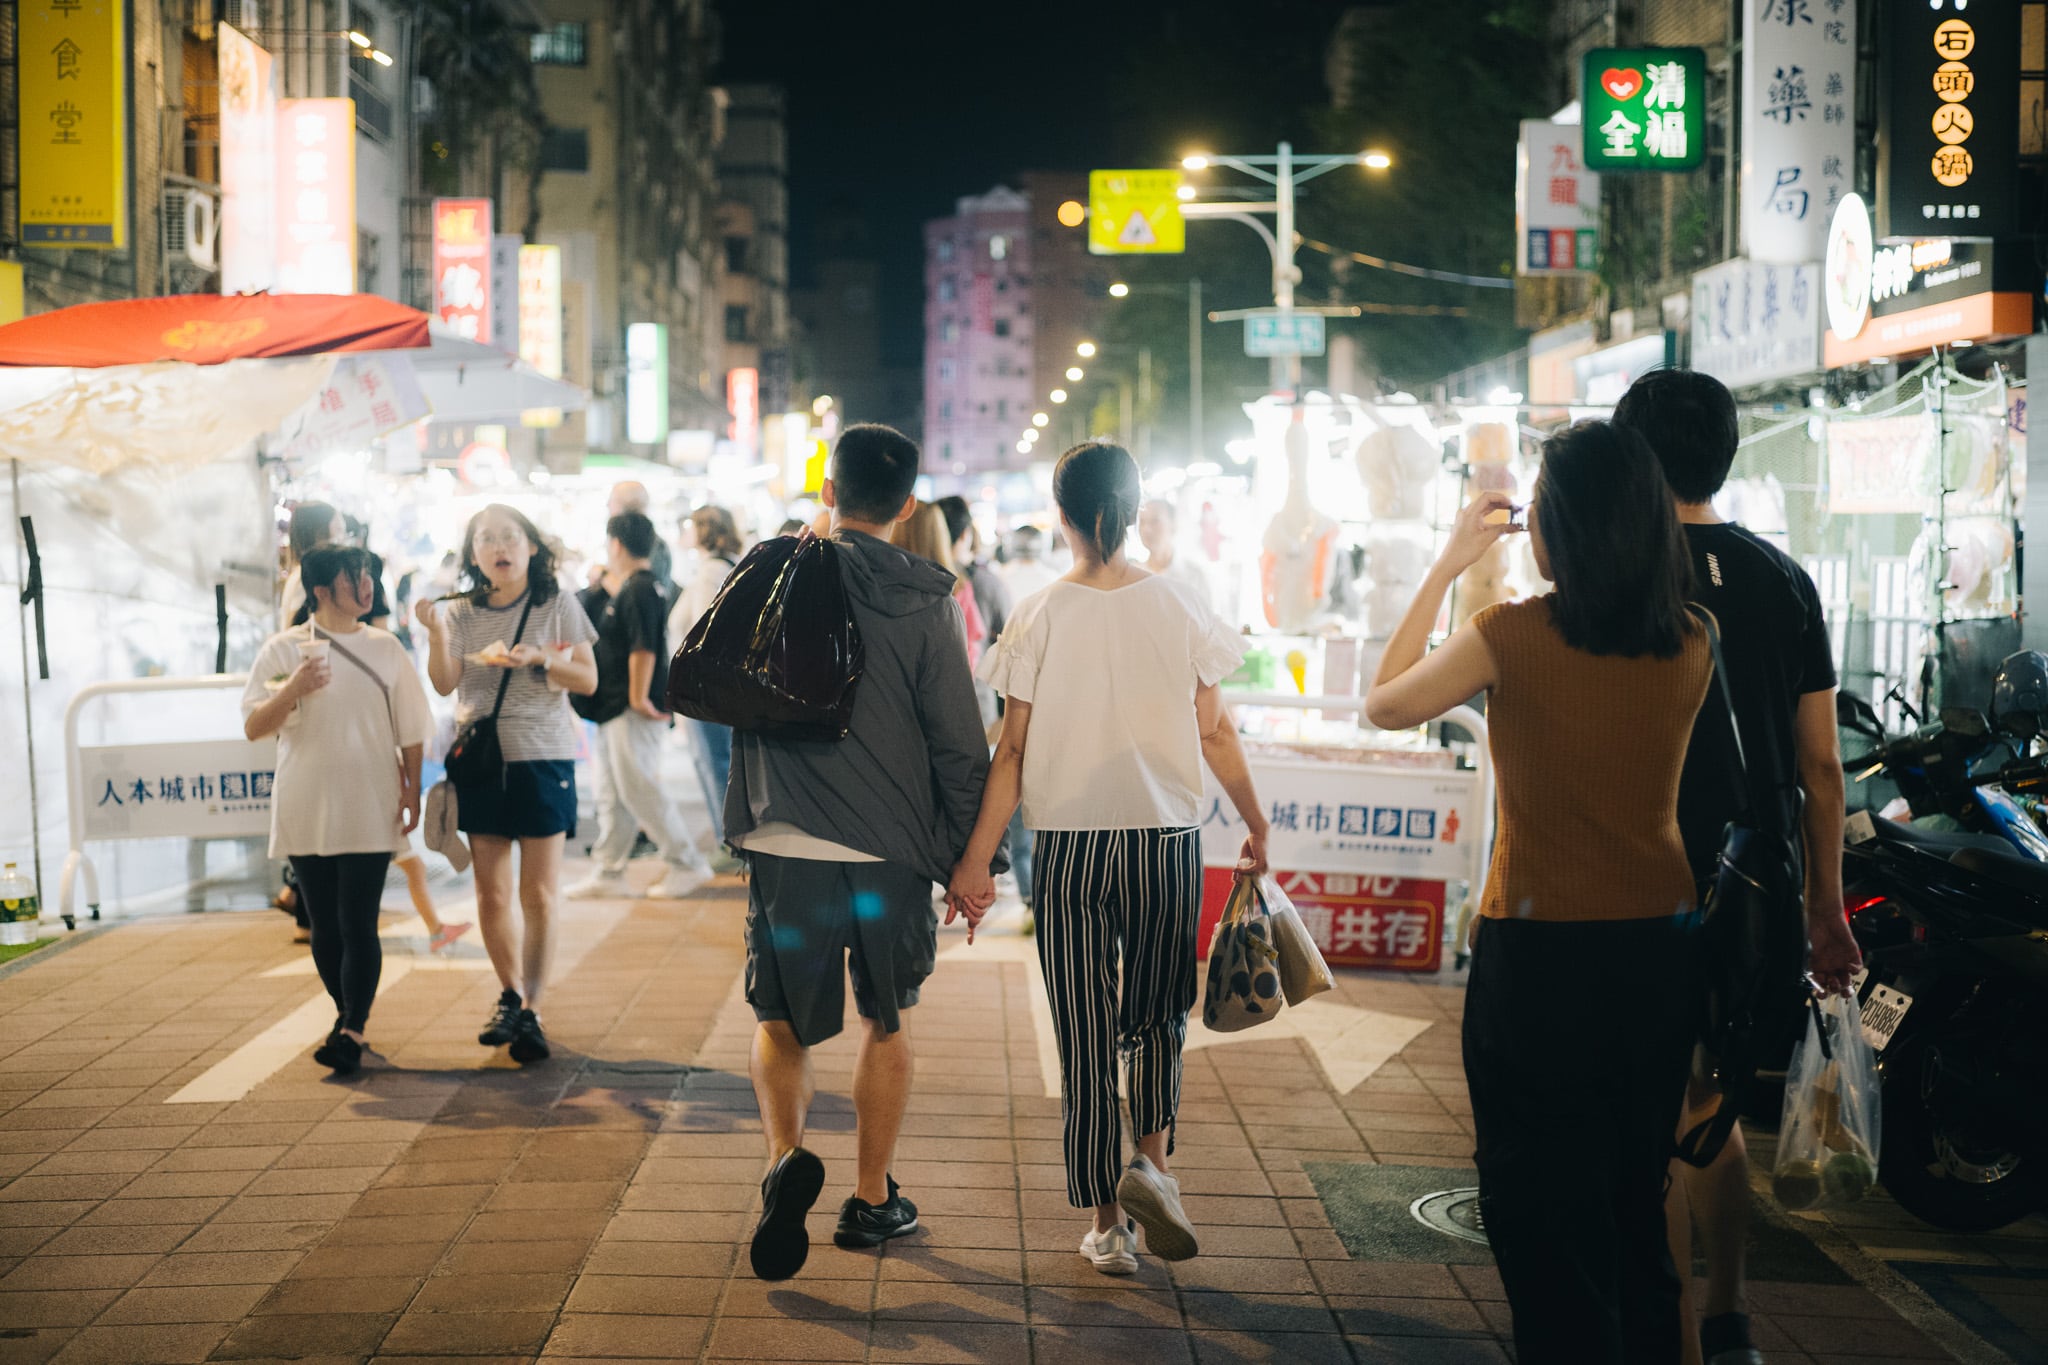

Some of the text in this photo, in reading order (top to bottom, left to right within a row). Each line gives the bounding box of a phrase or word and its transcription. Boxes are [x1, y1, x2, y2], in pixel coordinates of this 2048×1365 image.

[1202, 797, 1436, 840] 人城市漫步區
